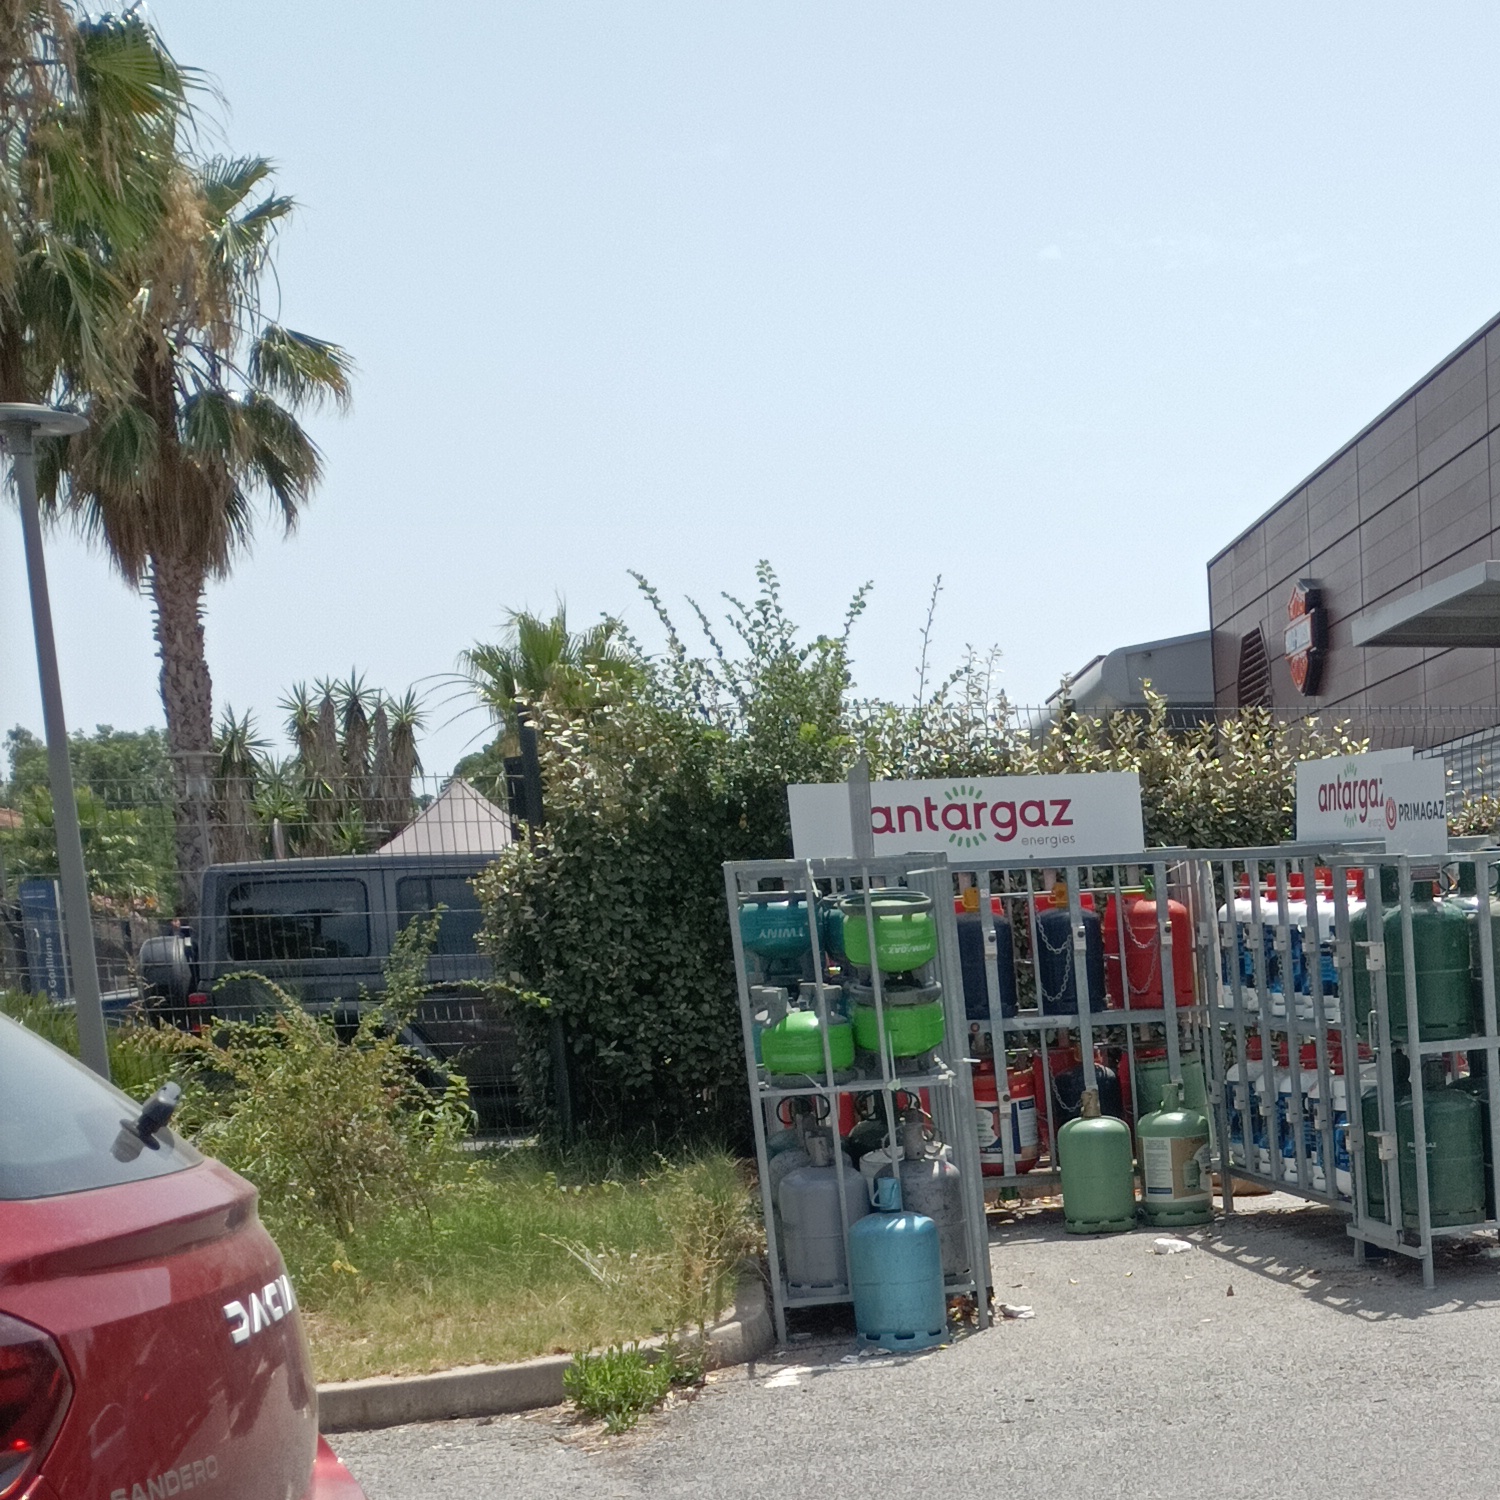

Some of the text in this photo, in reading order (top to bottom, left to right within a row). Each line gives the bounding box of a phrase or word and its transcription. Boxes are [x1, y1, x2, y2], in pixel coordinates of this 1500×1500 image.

[871, 796, 1074, 842] antargaz
[1398, 800, 1445, 822] PRIMAGAZ
[1021, 834, 1076, 848] energies
